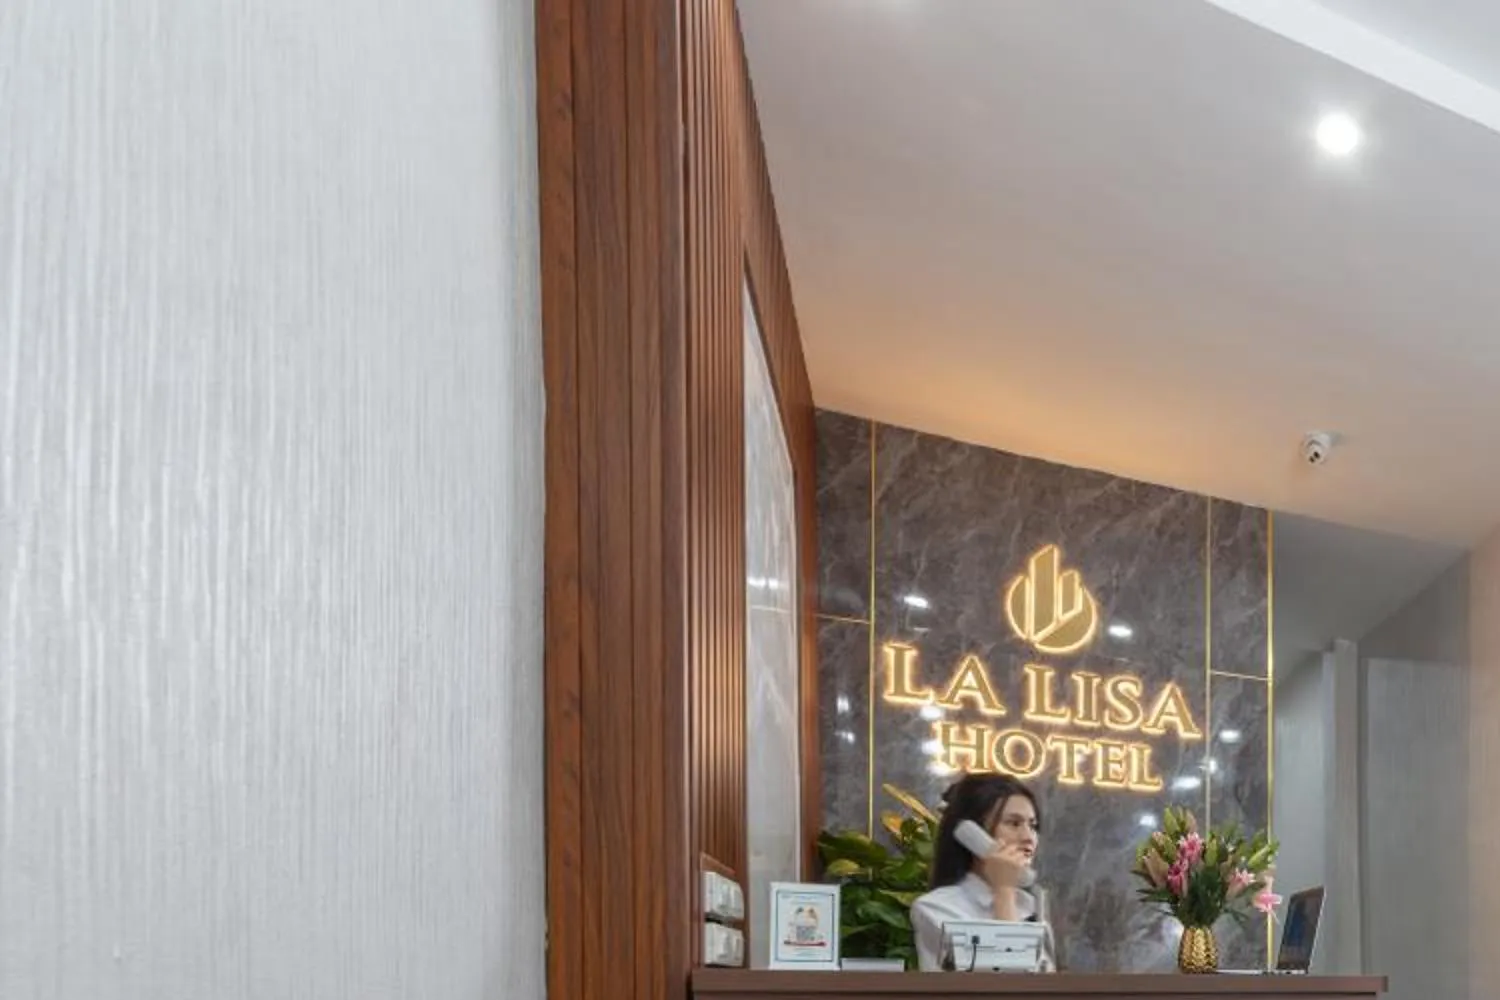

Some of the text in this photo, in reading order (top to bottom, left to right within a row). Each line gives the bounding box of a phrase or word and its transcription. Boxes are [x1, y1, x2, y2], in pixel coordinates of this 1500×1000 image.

[882, 641, 1200, 738] LA LISA
[937, 720, 1163, 791] HOTEL
